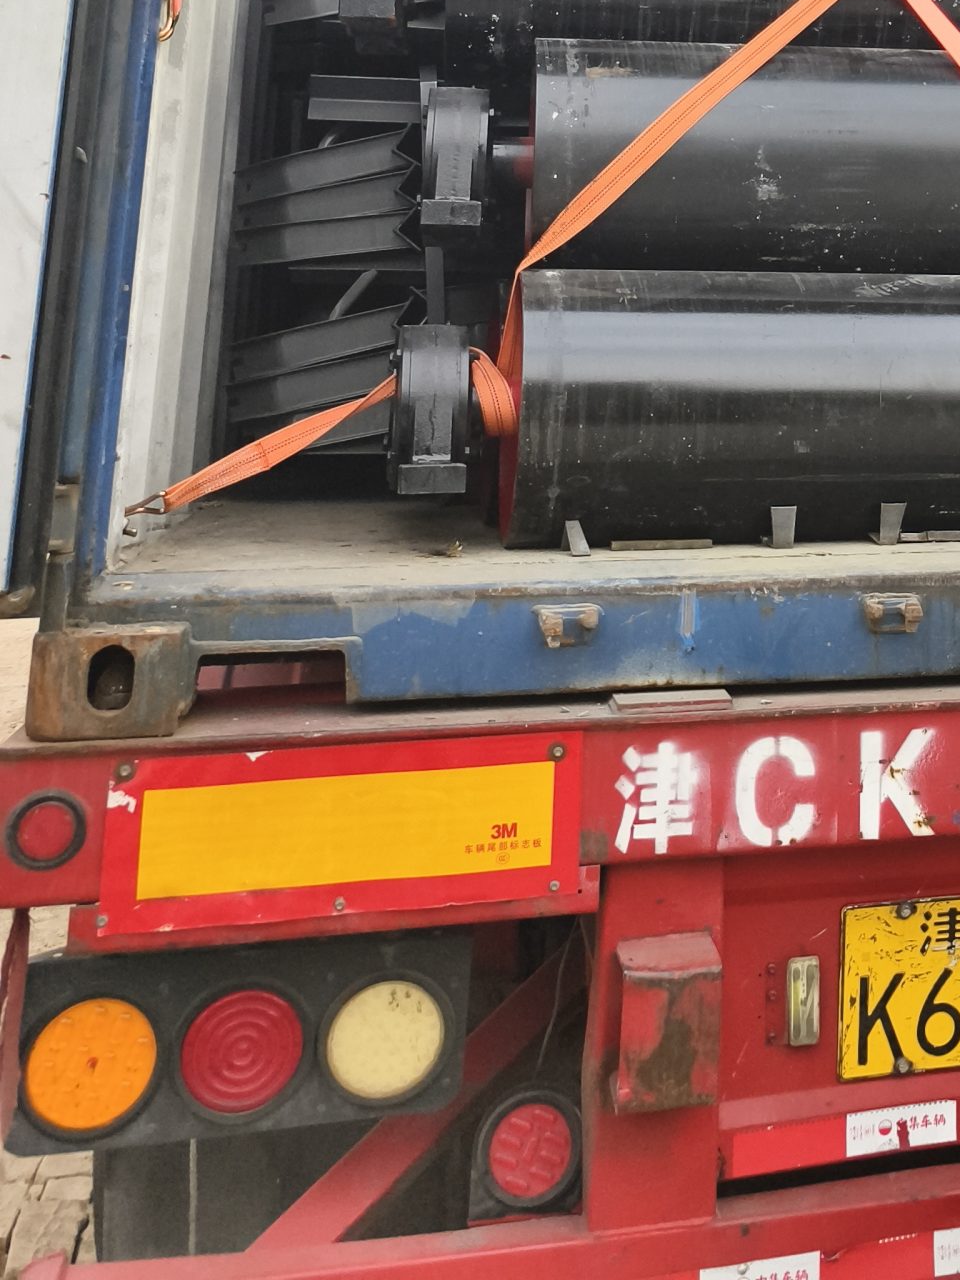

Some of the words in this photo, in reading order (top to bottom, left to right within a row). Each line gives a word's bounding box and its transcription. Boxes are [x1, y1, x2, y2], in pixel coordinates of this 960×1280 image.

[490, 822, 518, 840] 3M
[896, 1113, 946, 1131] 集车辆
